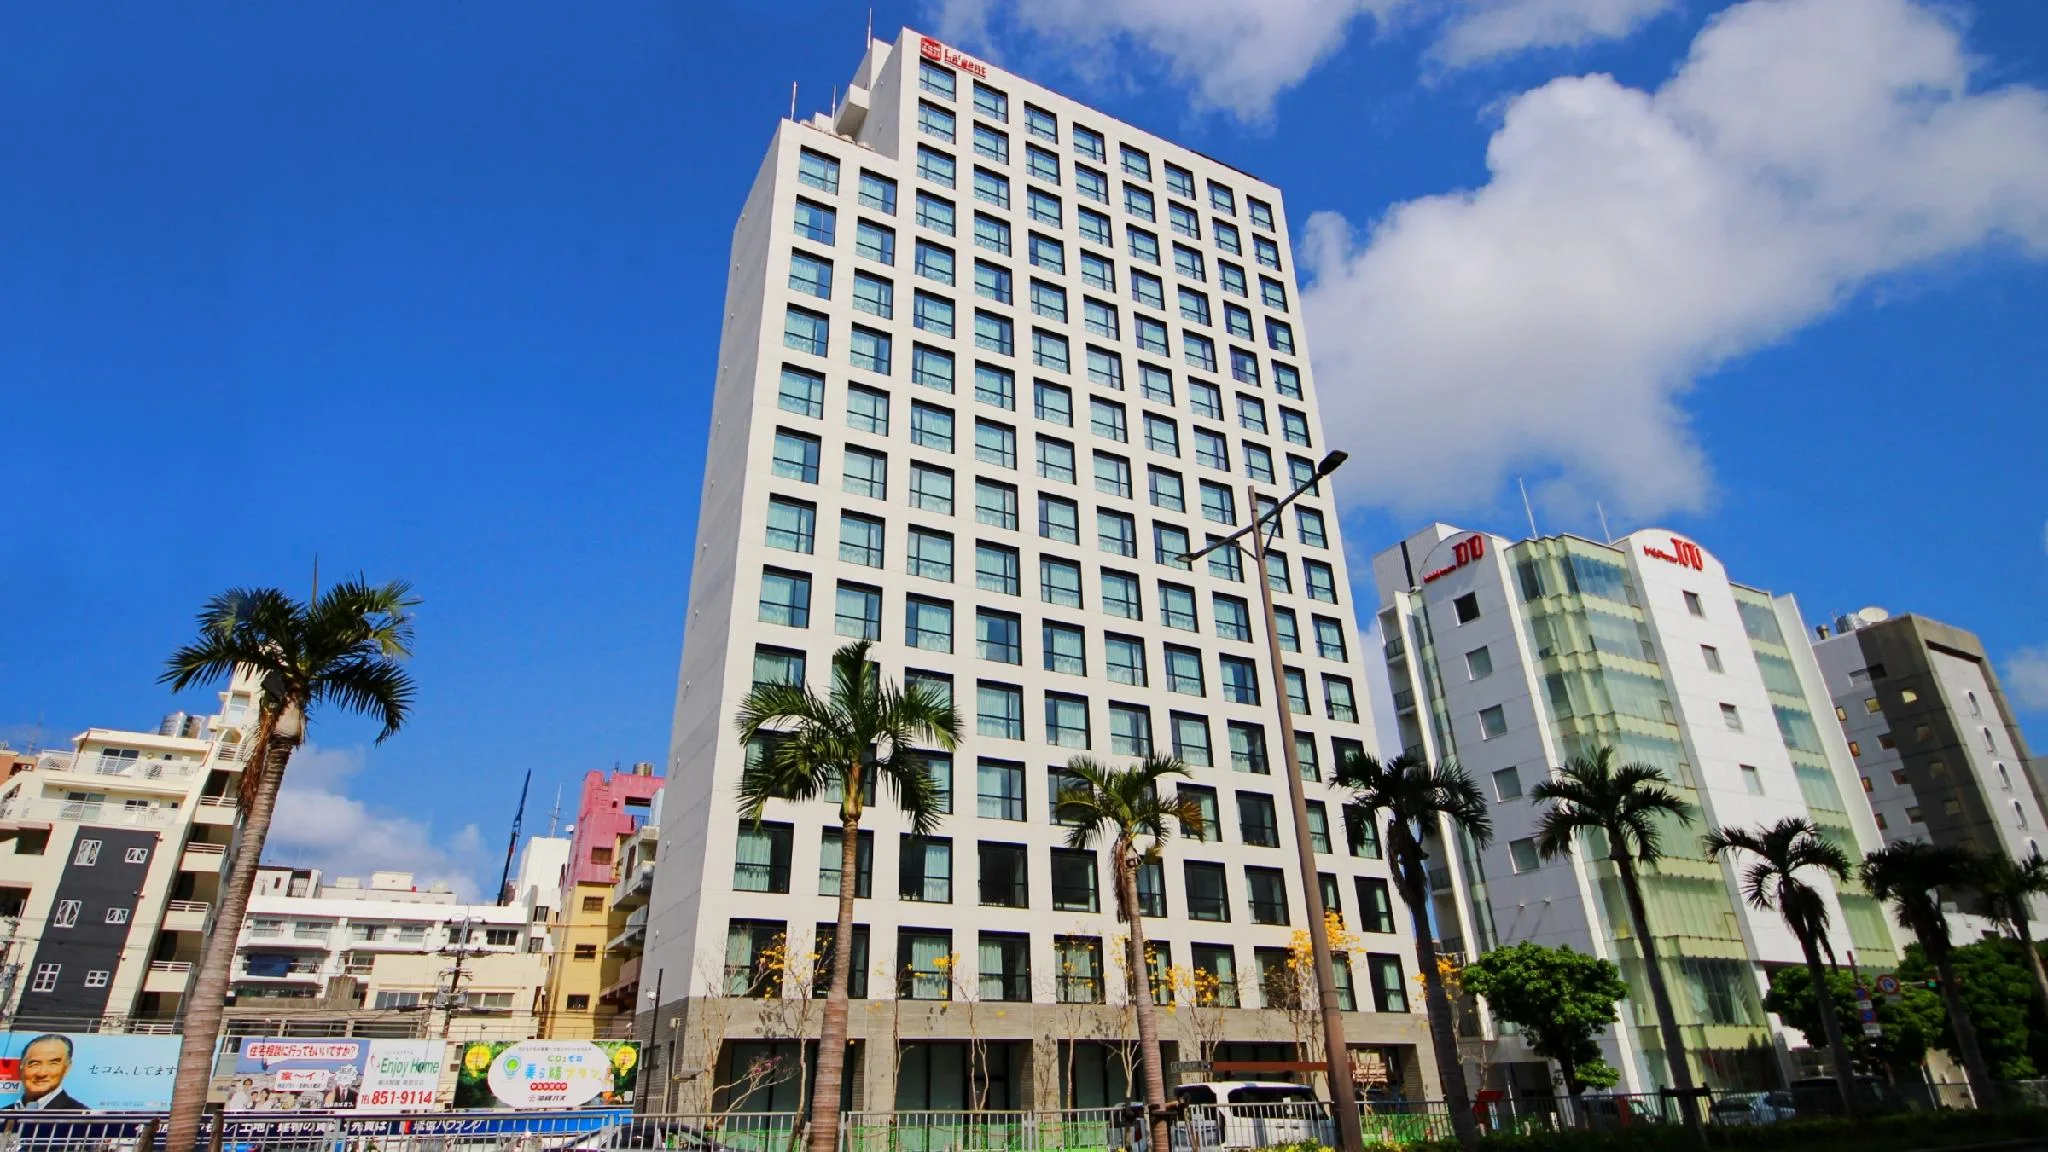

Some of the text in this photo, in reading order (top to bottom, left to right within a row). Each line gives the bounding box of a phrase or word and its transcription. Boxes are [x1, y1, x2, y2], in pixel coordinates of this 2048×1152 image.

[379, 1057, 440, 1078] Enjoy Home
[371, 1090, 433, 1104] 851-9114
